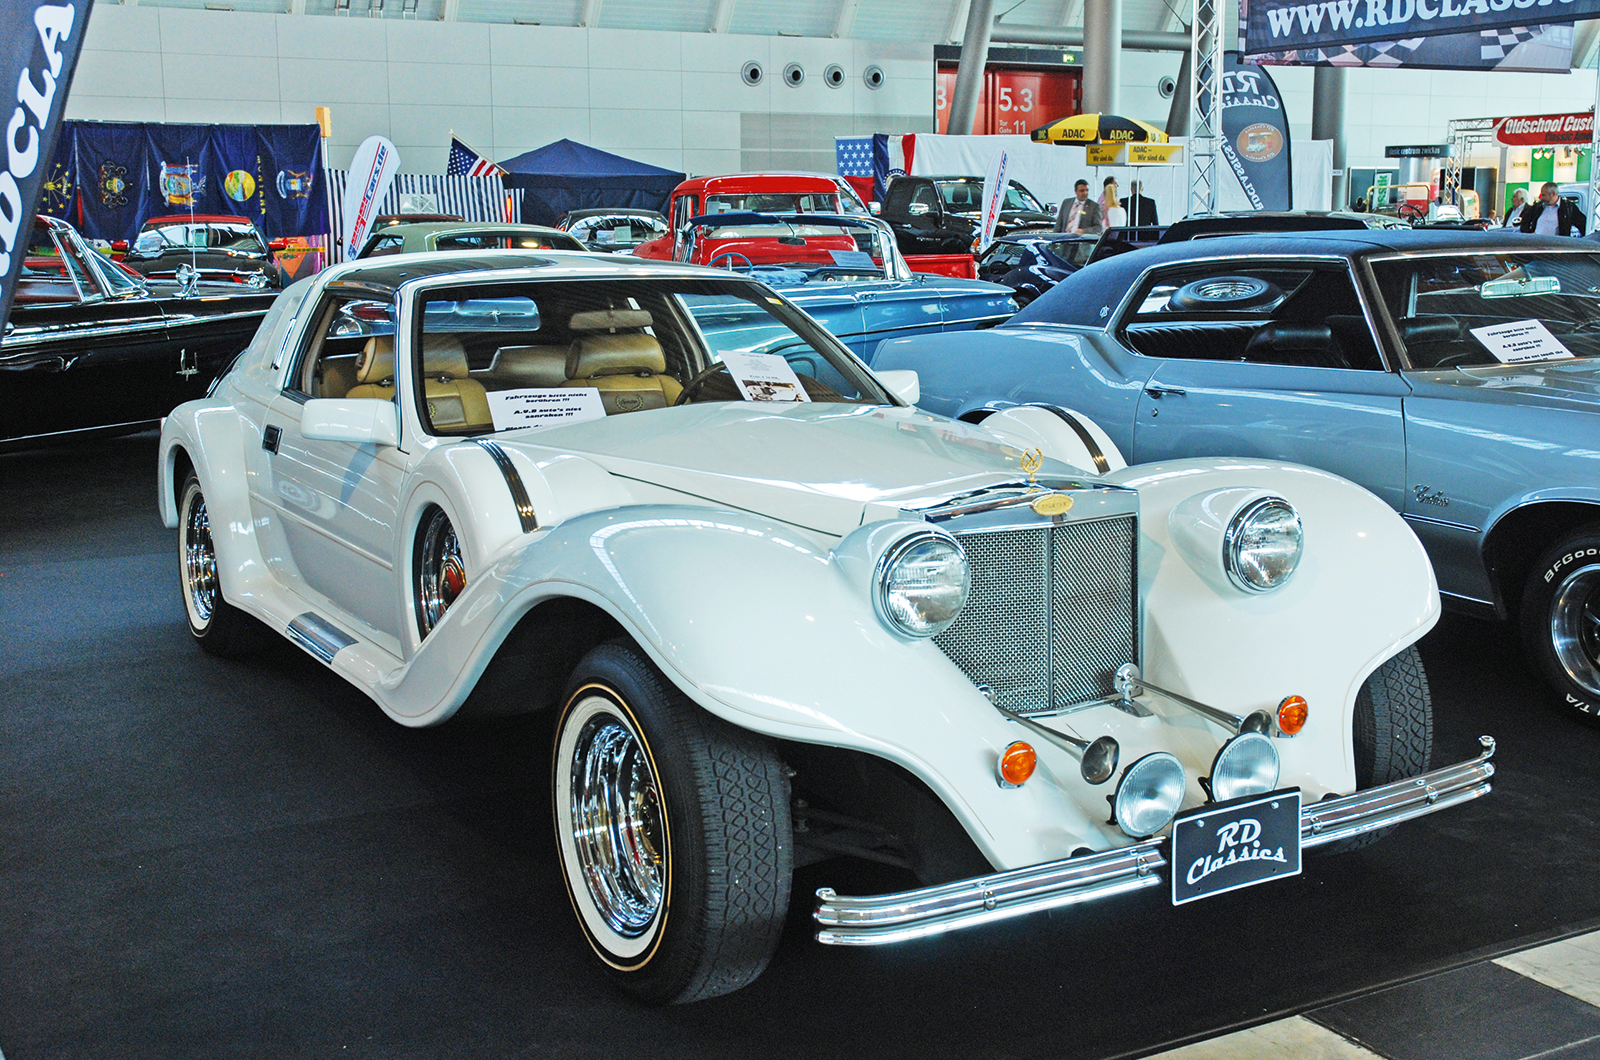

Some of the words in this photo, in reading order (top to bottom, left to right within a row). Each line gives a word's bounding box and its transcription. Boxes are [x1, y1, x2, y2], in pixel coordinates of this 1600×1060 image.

[1267, 0, 1575, 38] WWW.RDCLA
[999, 87, 1033, 112] 5.3
[0, 3, 75, 276] DCLA
[1014, 120, 1026, 133] 11
[1062, 128, 1085, 138] ADAC
[1110, 129, 1135, 140] ADAC
[1505, 117, 1564, 134] Oldschool
[257, 155, 266, 214] MONTANA
[1217, 818, 1262, 854] RD
[1186, 840, 1288, 885] Classics
